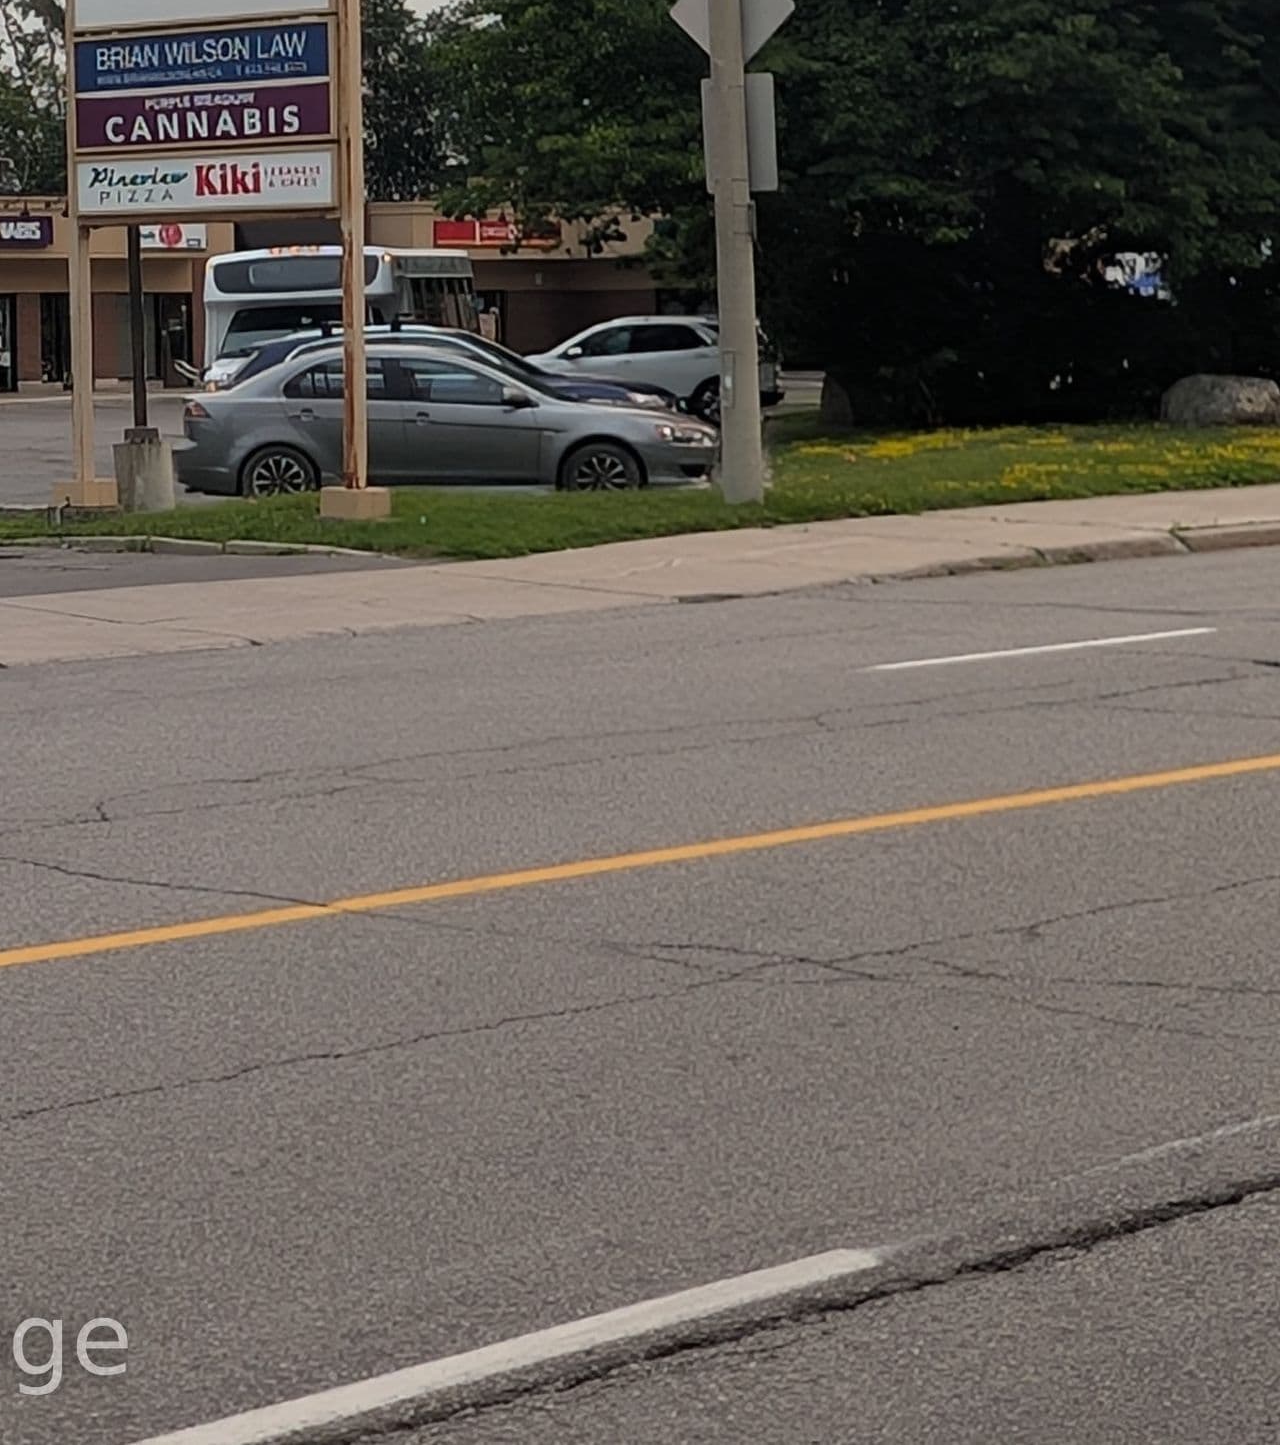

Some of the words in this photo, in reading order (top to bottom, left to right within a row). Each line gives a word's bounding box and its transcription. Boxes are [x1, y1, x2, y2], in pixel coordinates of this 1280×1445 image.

[96, 43, 159, 71] BRIAN
[164, 36, 250, 66] WILSON
[257, 30, 307, 59] LAW
[105, 105, 301, 144] CANNABIS
[99, 188, 175, 205] PIZZA
[195, 162, 262, 197] Kiki
